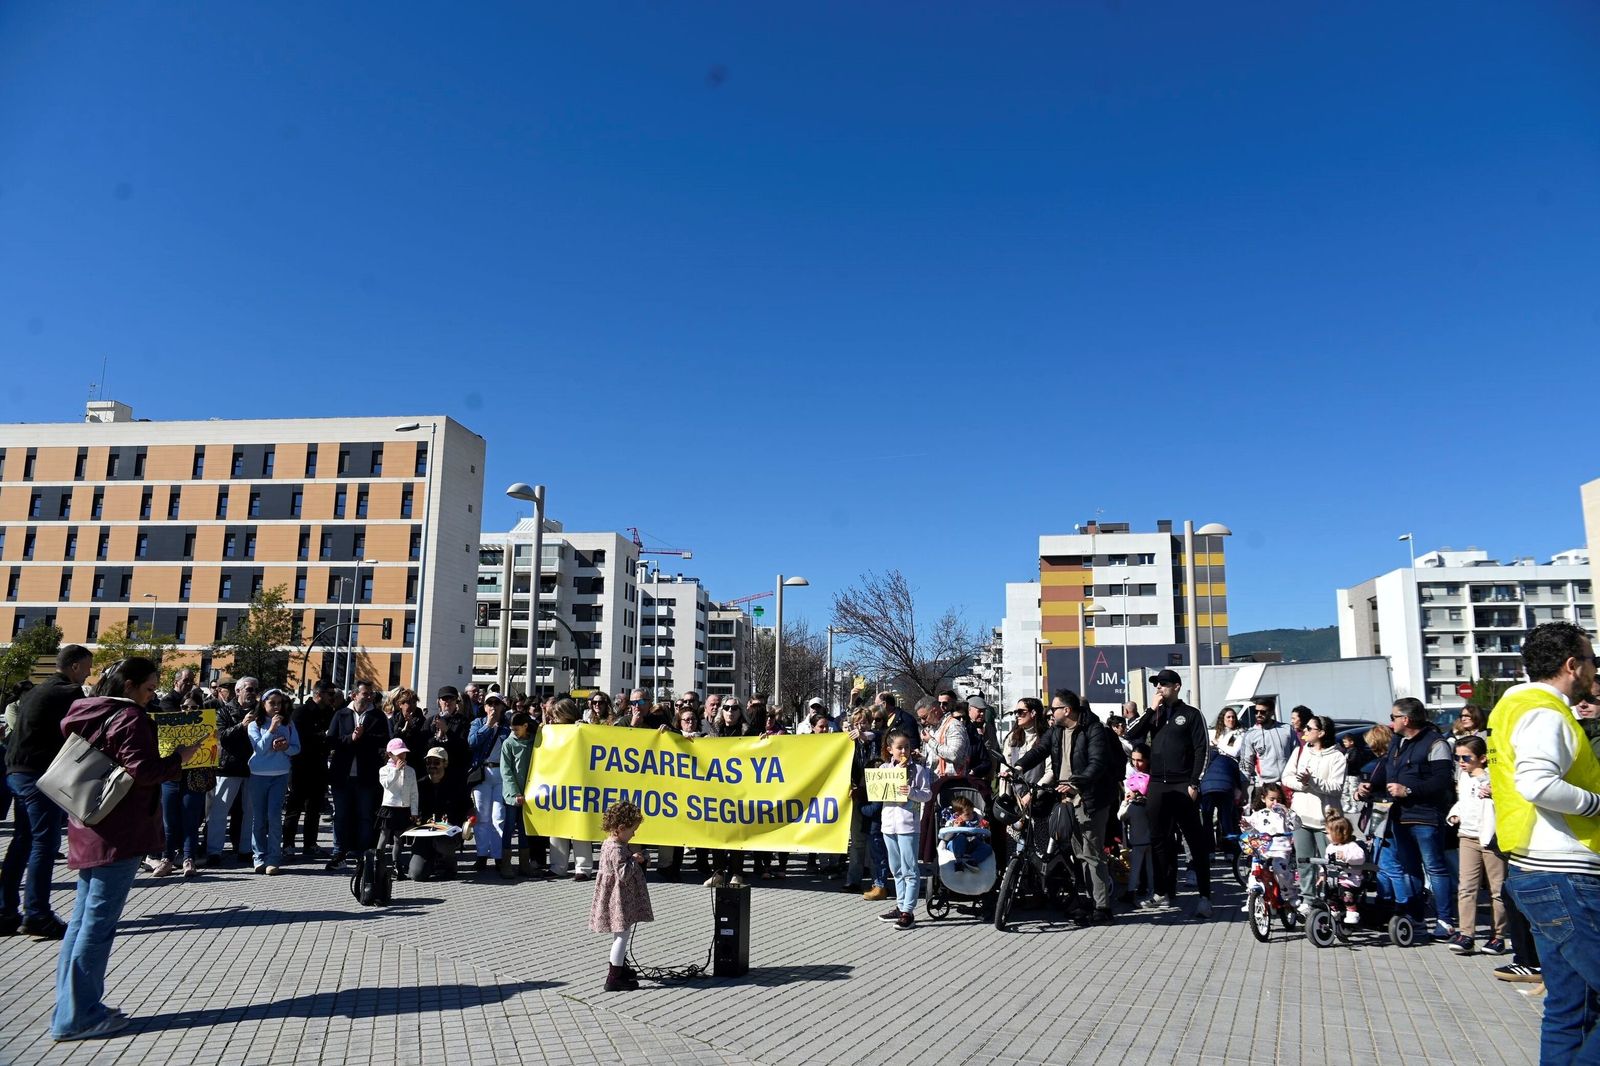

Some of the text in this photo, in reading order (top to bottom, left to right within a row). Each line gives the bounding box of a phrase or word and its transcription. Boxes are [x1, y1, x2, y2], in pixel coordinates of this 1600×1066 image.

[1097, 672, 1118, 685] JM
[590, 745, 784, 784] PASARELAS YA
[535, 784, 839, 824] QUEREMOS SEGURIDAD
